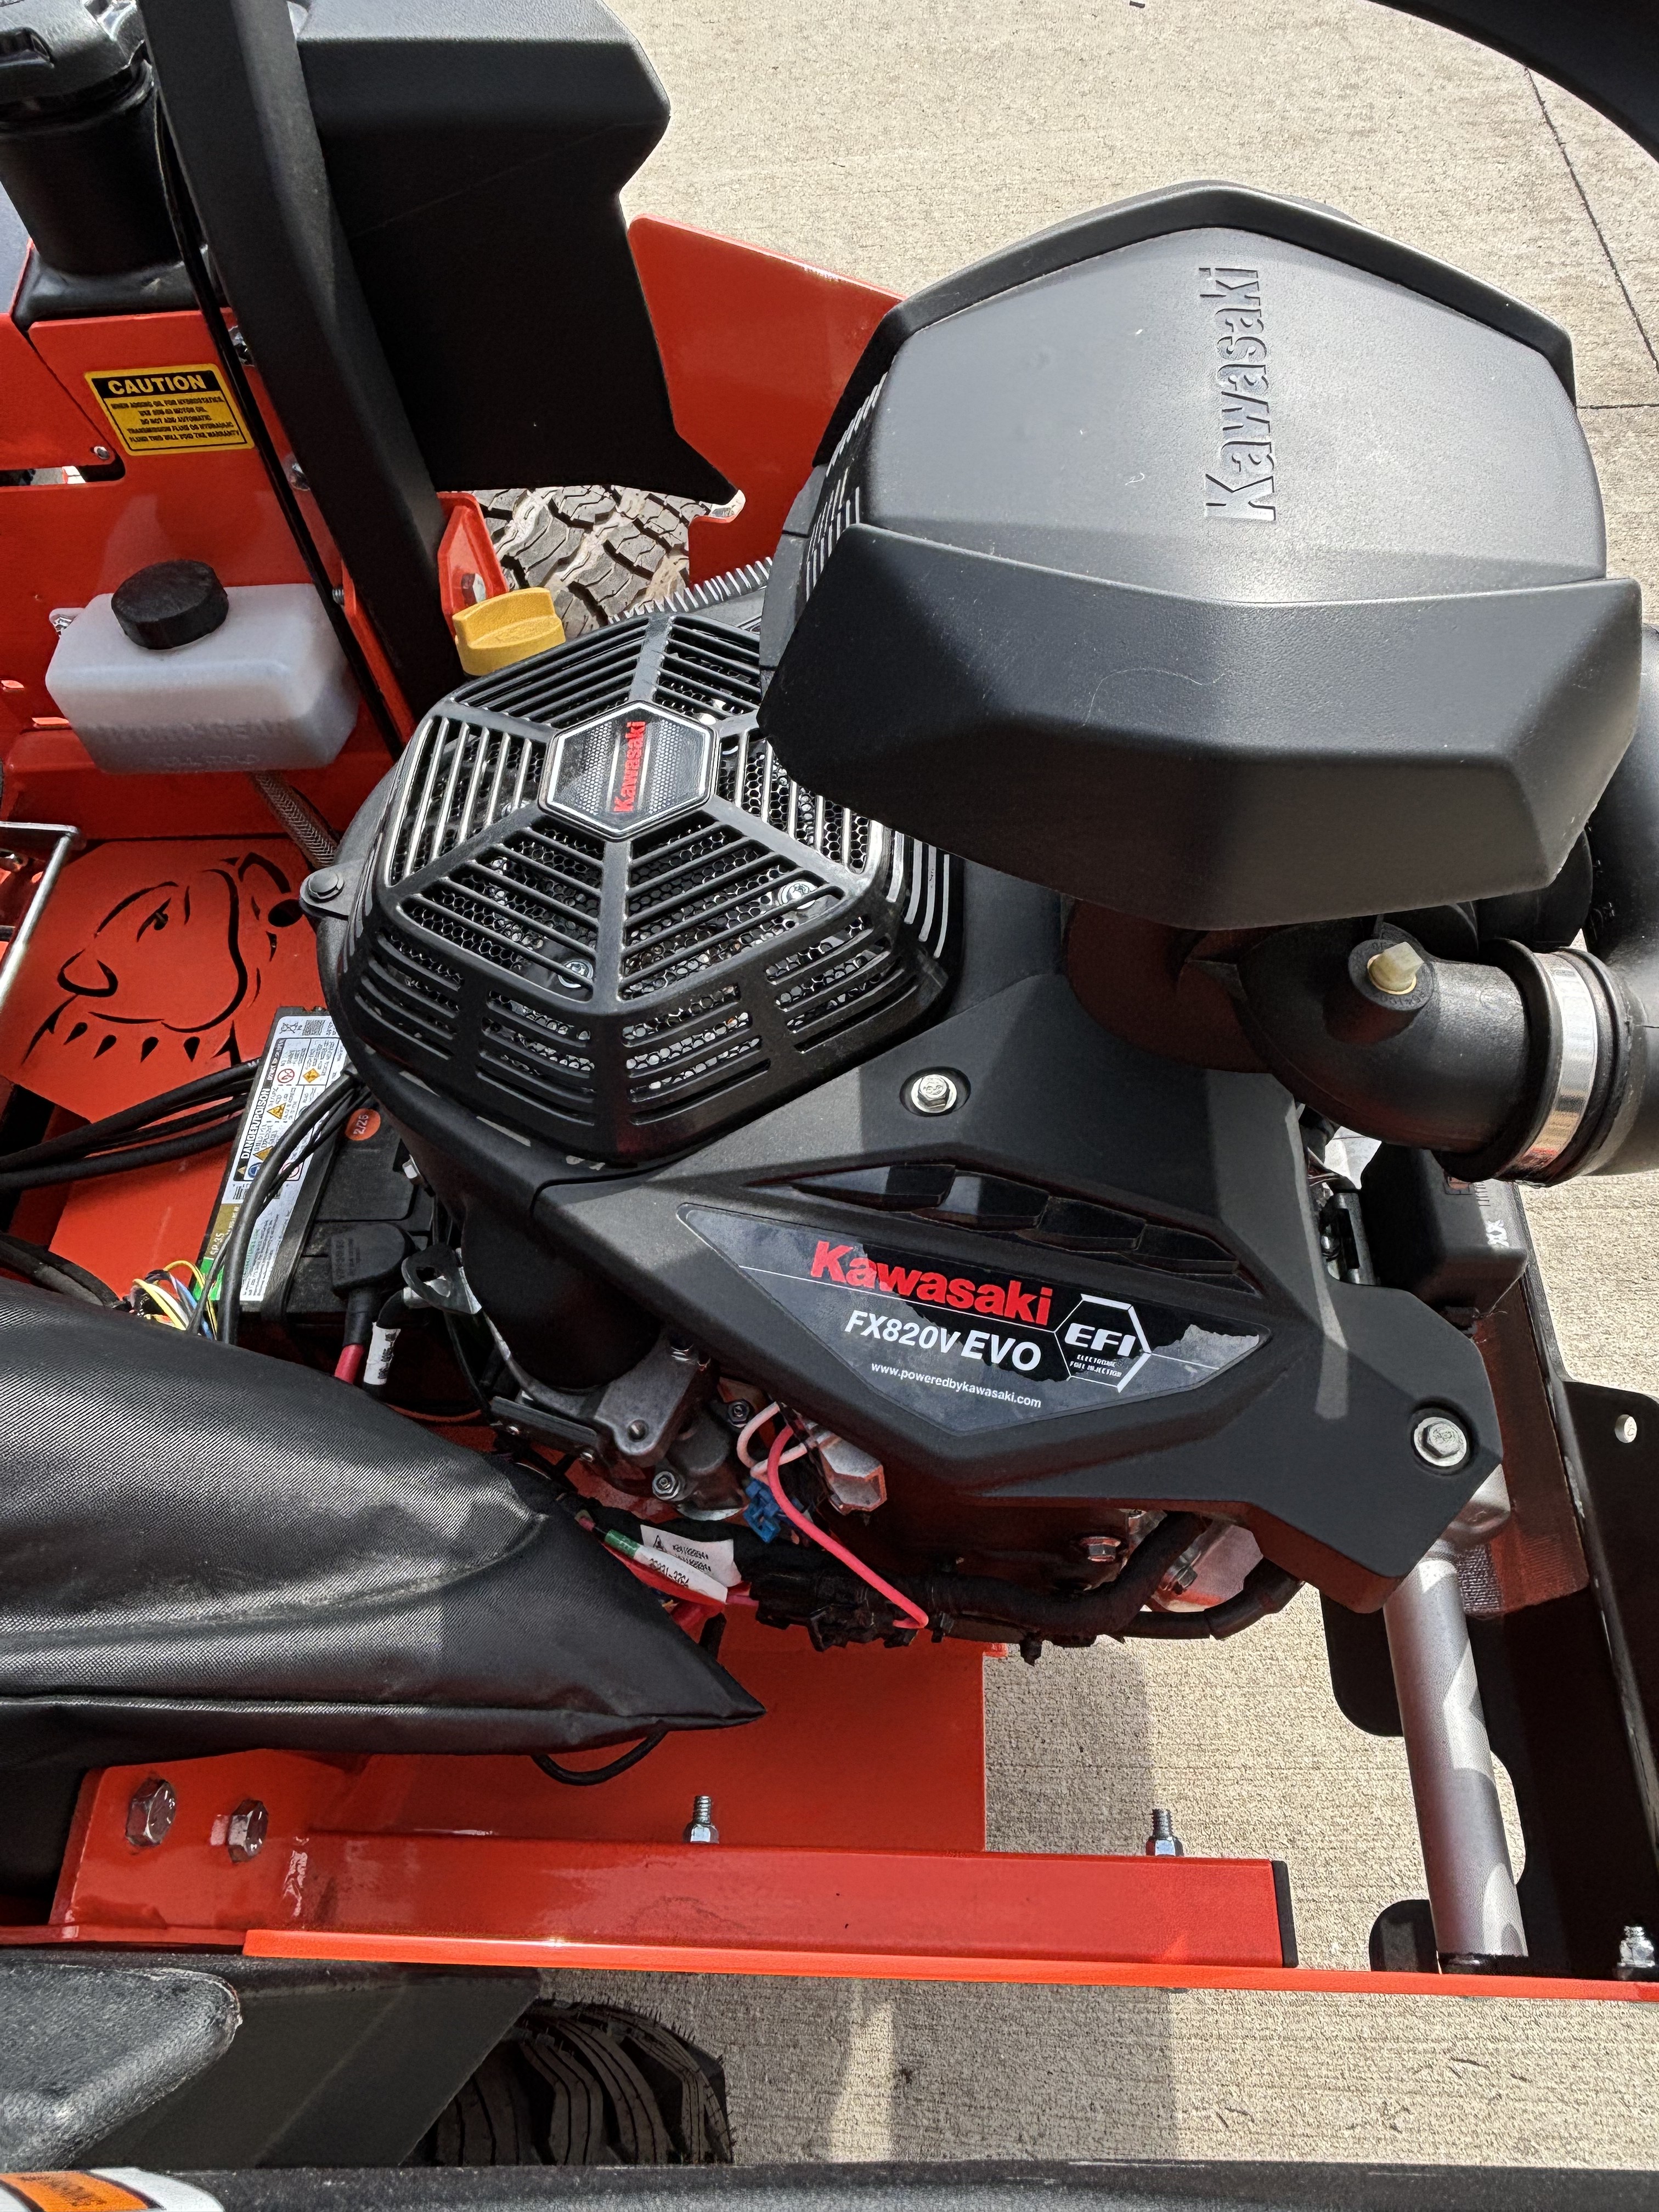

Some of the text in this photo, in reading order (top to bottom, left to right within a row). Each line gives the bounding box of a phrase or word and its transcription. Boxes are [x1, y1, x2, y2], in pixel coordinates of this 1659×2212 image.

[108, 374, 207, 395] CAUTION
[1198, 267, 1277, 522] Kawasaki
[613, 721, 646, 812] Kawasaki
[810, 1240, 1053, 1326] Kawasaki
[844, 1310, 1041, 1372] FX820V EVO
[1064, 1322, 1136, 1357] EFI
[871, 1361, 1041, 1409] www.poweredbykawasaki.com
[1087, 1364, 1122, 1378] INJECTION
